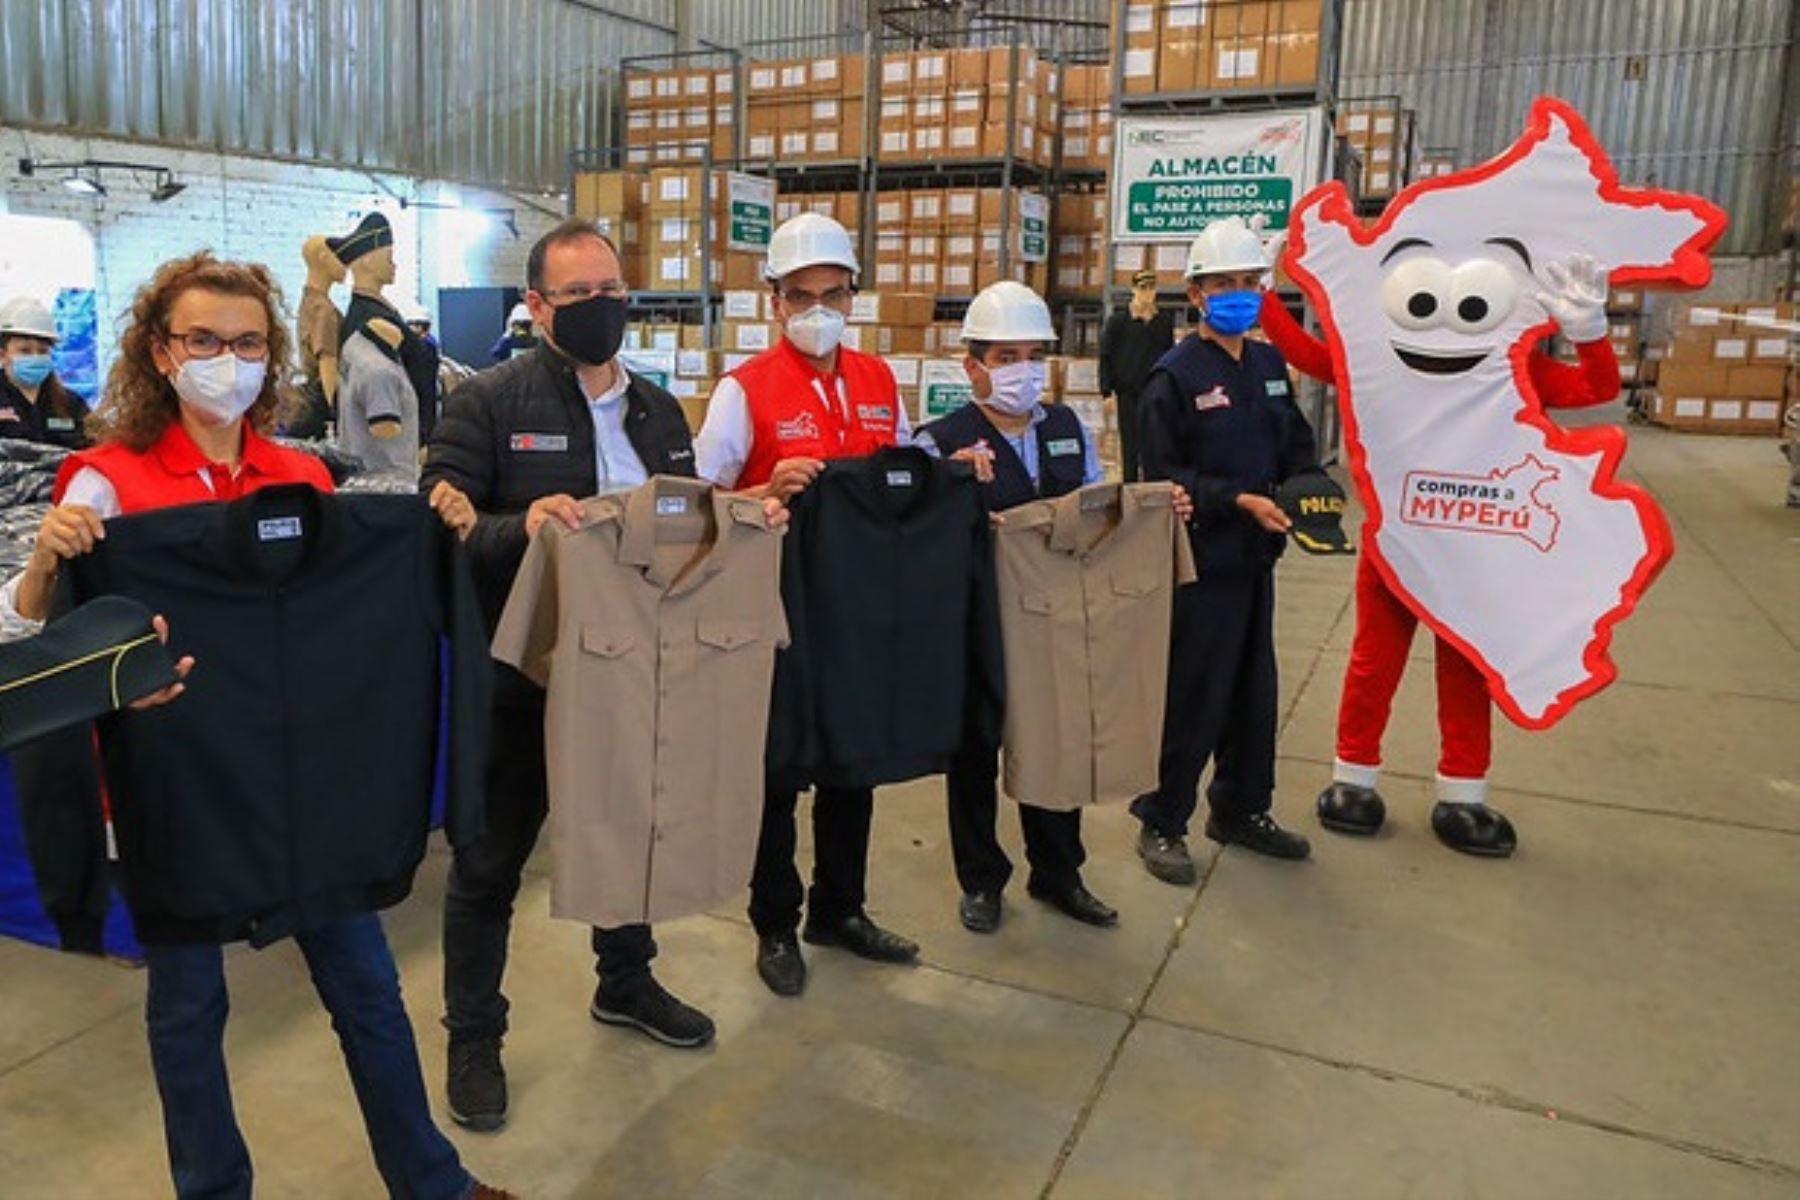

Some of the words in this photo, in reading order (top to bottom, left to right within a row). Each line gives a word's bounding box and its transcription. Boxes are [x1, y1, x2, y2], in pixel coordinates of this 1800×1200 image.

[1148, 151, 1276, 176] ALMACÉN
[1155, 183, 1260, 200] PROHIBIDO
[1133, 203, 1149, 214] EL
[1192, 201, 1204, 213] A
[1206, 200, 1286, 213] PERSONAS
[1143, 217, 1166, 228] NO
[1417, 479, 1500, 499] compras
[1504, 489, 1515, 500] a
[1411, 497, 1532, 529] MYPErú
